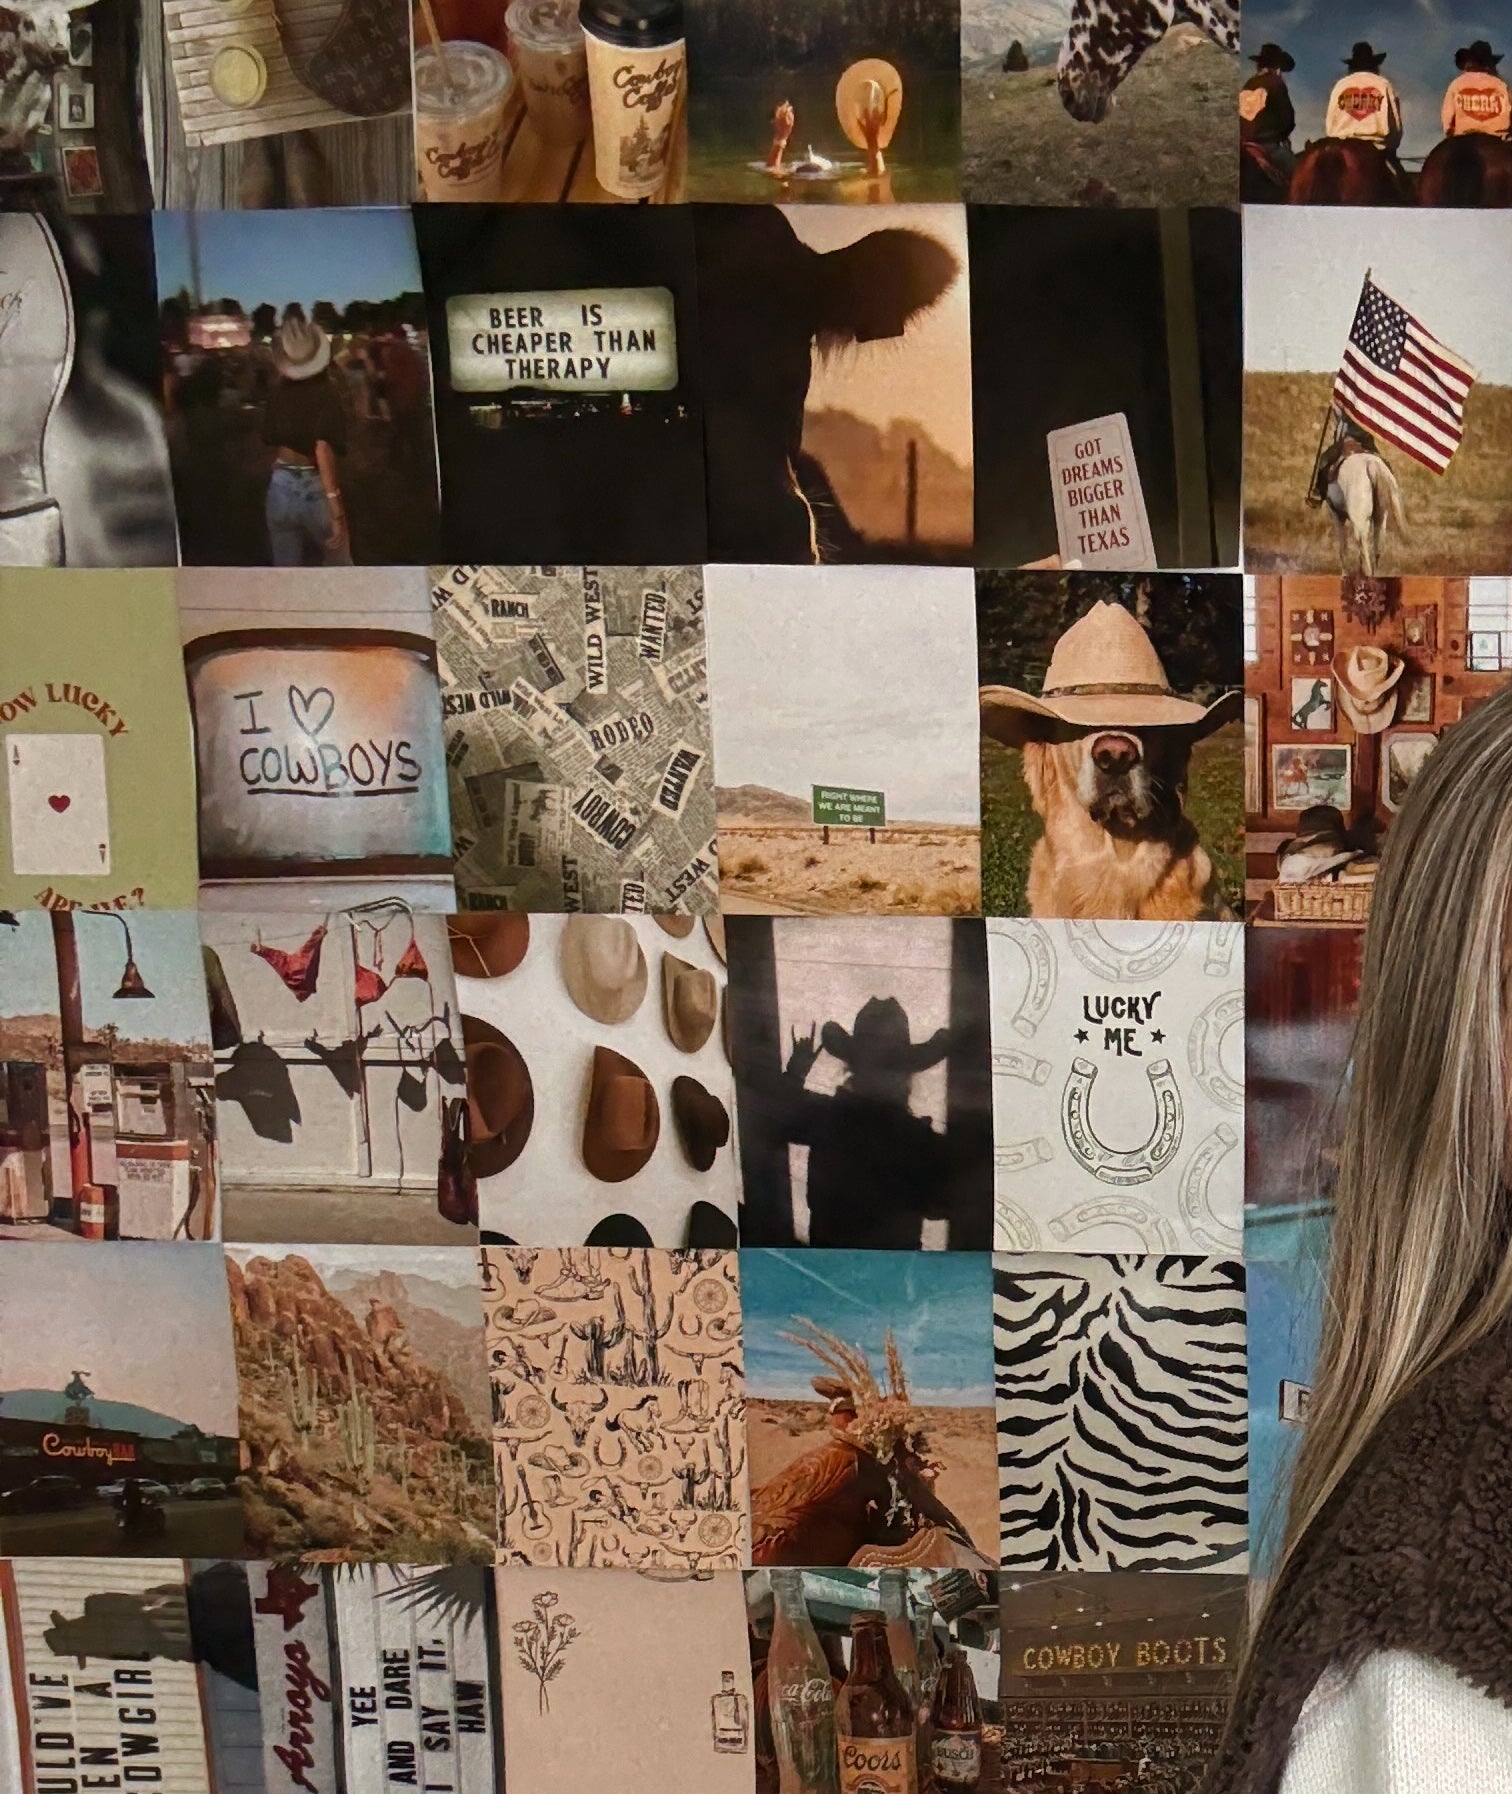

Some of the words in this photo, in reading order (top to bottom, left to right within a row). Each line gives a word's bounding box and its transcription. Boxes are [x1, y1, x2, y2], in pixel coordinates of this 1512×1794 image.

[490, 306, 544, 329] BEER
[582, 304, 603, 326] IS
[472, 331, 573, 355] CHEAPER
[594, 329, 657, 352] THAN
[505, 357, 611, 380] THERAPY
[1075, 437, 1102, 459] GOT
[1062, 455, 1124, 486] DREAMS
[1068, 479, 1124, 508] BIGGER
[1078, 503, 1122, 529] THAN
[1077, 526, 1130, 555] TEXAS
[491, 599, 530, 618] RANCH
[583, 566, 603, 625] WEST
[639, 592, 667, 660] WANTED
[587, 633, 605, 689] WILD
[0, 684, 38, 724] OW
[44, 683, 129, 738] LUCKY
[233, 690, 272, 735] I
[590, 711, 655, 752] RODEO
[239, 739, 423, 791] COWBOYS
[659, 749, 701, 812] WANTED
[572, 788, 637, 850] COWBOY
[818, 801, 833, 811] WE
[834, 803, 852, 812] ARE
[853, 804, 881, 814] MEANT
[839, 813, 851, 823] TO
[664, 857, 711, 903] WEST
[1083, 990, 1162, 1025] LUCKY
[1103, 1027, 1143, 1057] ME
[43, 1432, 113, 1467] Cowboy
[1023, 1641, 1121, 1671] COWBOY
[73, 1681, 113, 1699] A
[383, 1648, 413, 1711] DARE
[350, 1685, 379, 1728] YEE
[455, 1680, 486, 1734] HAW
[421, 1704, 452, 1752] SAY
[387, 1739, 418, 1786] AND
[843, 1745, 901, 1771] Coors
